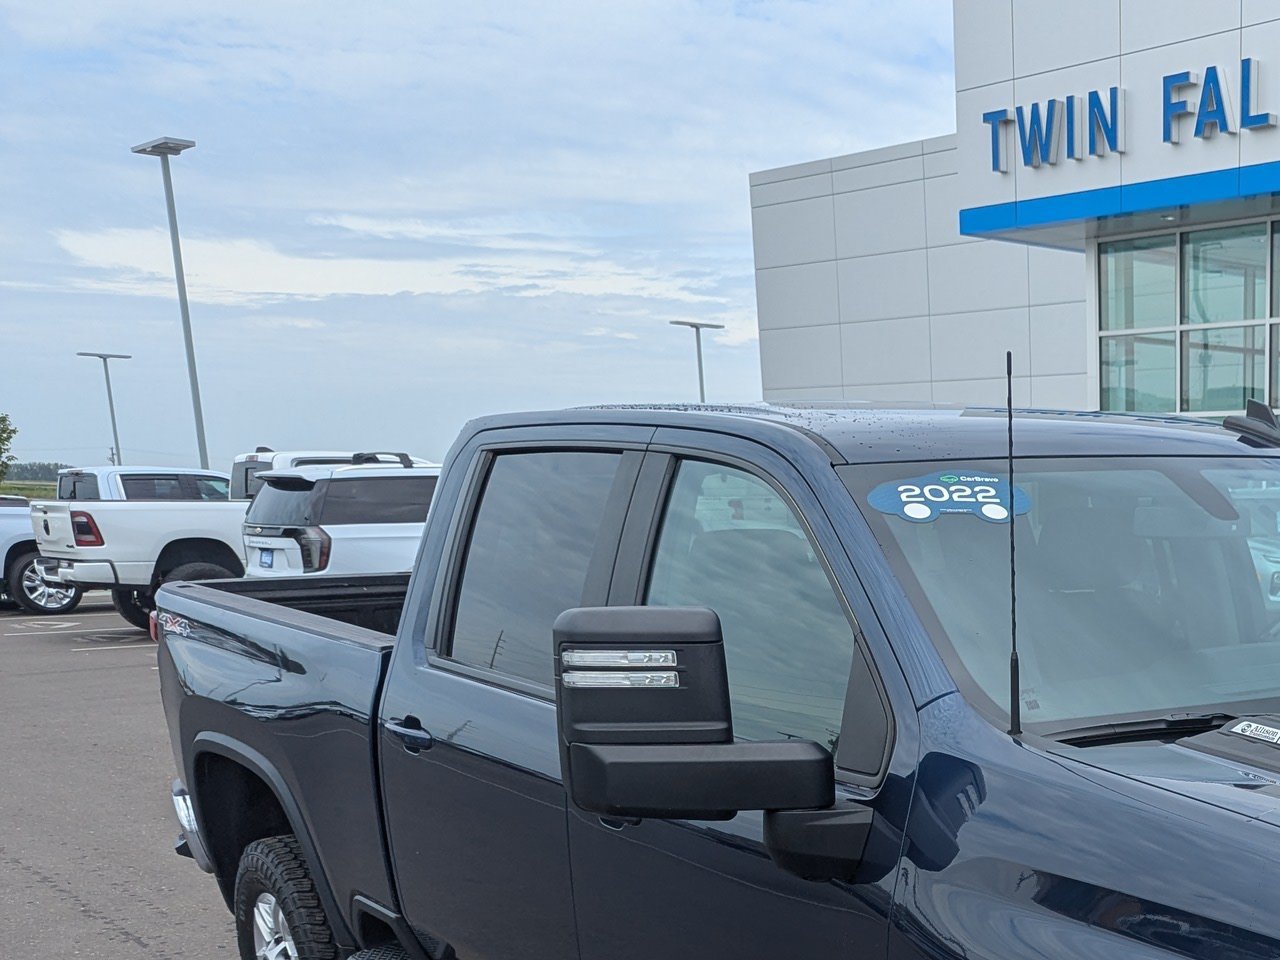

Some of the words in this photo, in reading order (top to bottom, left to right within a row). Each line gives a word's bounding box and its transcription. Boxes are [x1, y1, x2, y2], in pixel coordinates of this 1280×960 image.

[982, 86, 1126, 173] TWIN
[897, 484, 1001, 503] 2022
[1250, 725, 1280, 738] Allison
